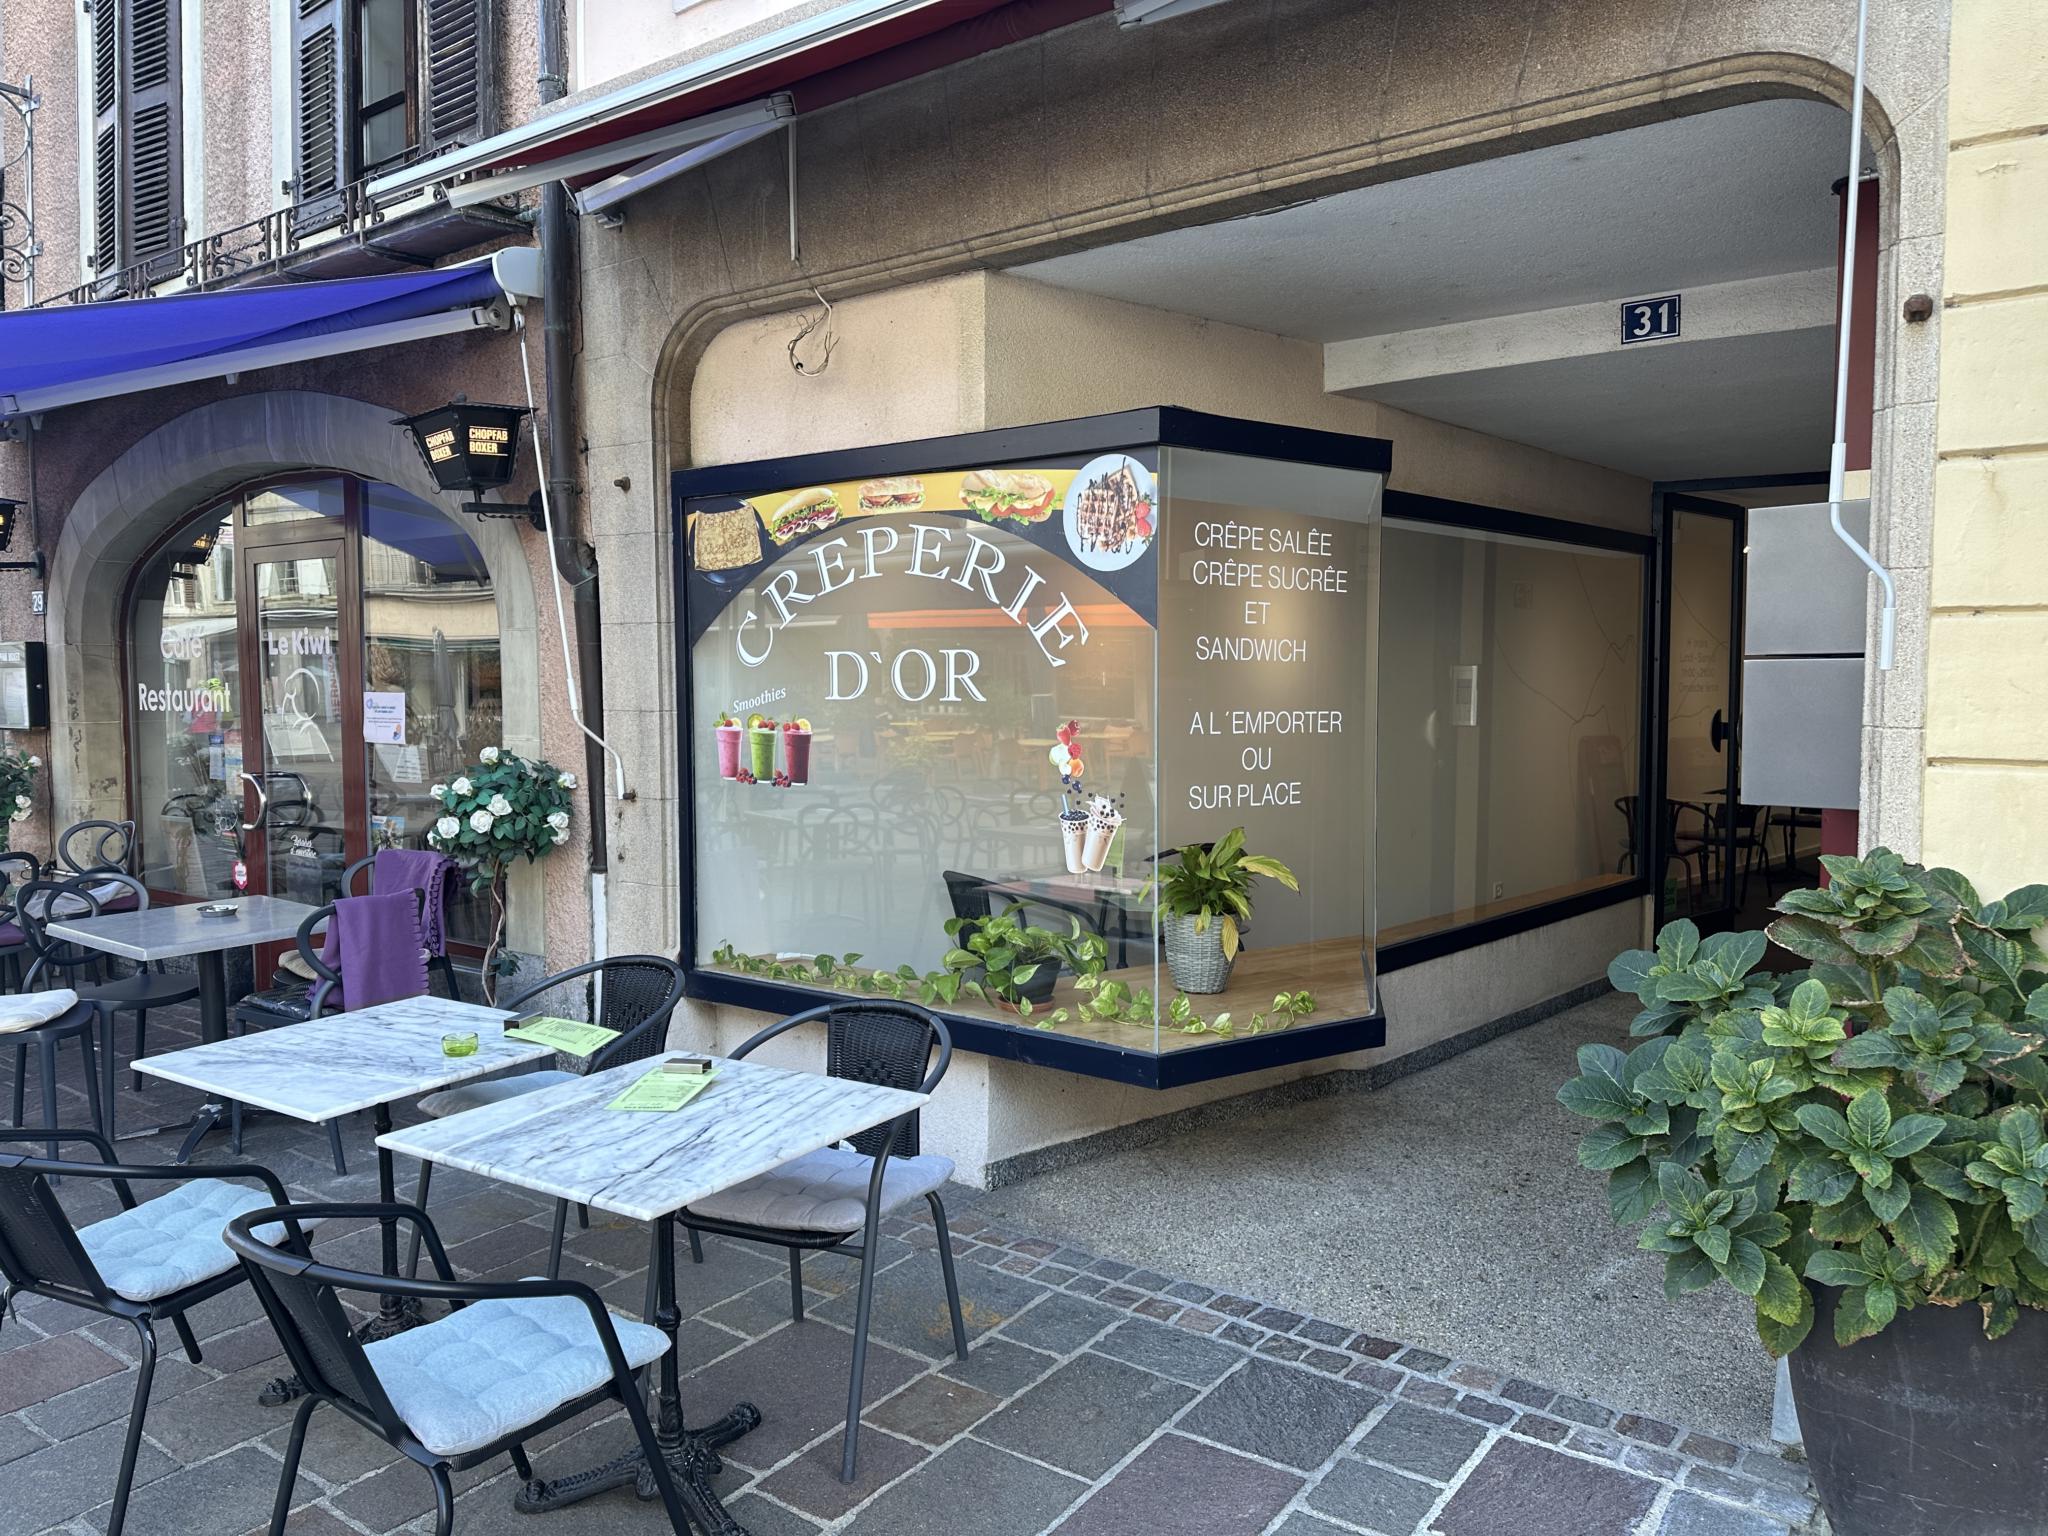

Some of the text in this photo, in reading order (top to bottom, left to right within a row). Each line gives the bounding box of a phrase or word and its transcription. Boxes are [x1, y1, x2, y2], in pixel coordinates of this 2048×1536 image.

[1633, 302, 1669, 336] 31
[425, 430, 455, 448] CHOPFAB
[469, 427, 508, 441] CHOPFAB
[469, 441, 498, 453] BOXER
[429, 445, 452, 461] BOXER
[1194, 520, 1264, 551] CRÊPE
[1193, 558, 1263, 588] CRÊPE
[32, 595, 43, 612] 29
[735, 523, 1089, 668] CREPERIE
[1244, 601, 1271, 625] ET
[160, 629, 202, 659] Café
[268, 626, 331, 656] Le Kiwi
[1195, 636, 1307, 663] SANDWICH
[138, 682, 231, 713] Restaurant
[733, 687, 786, 714] Smoothies
[1189, 711, 1204, 735] A
[1241, 747, 1272, 771] OU
[1188, 782, 1302, 810] SUR PLACE
